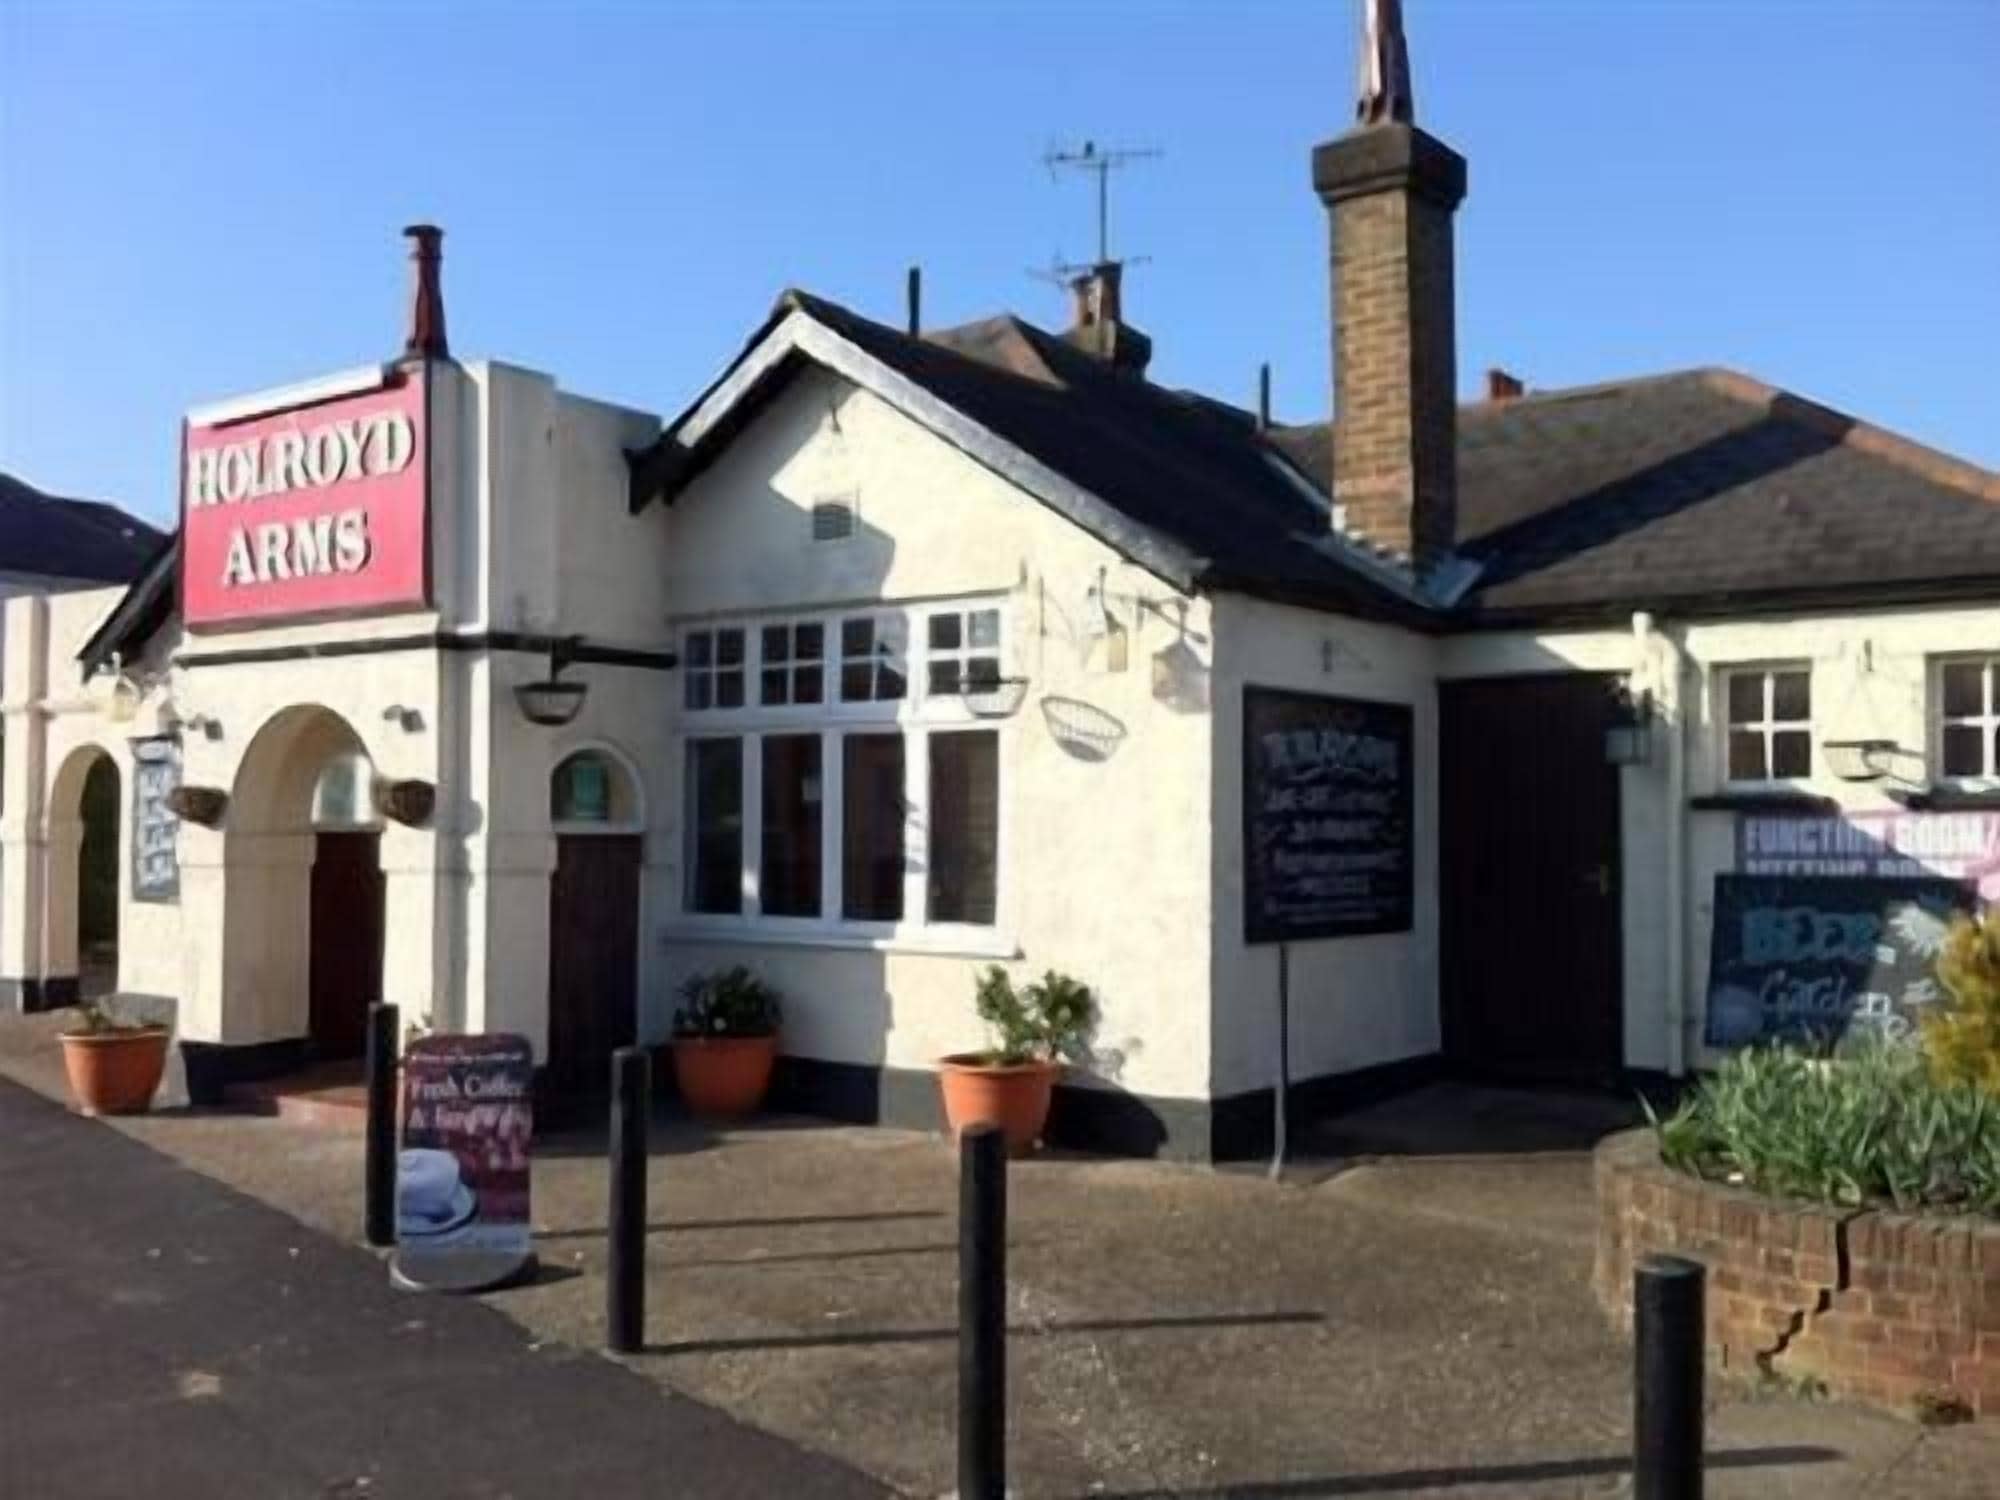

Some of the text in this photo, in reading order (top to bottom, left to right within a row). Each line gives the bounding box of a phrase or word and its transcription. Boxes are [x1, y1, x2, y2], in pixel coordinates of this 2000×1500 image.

[189, 410, 413, 505] HOLROYD
[223, 510, 370, 586] ARMS
[1745, 817, 1886, 854] FUNCTION
